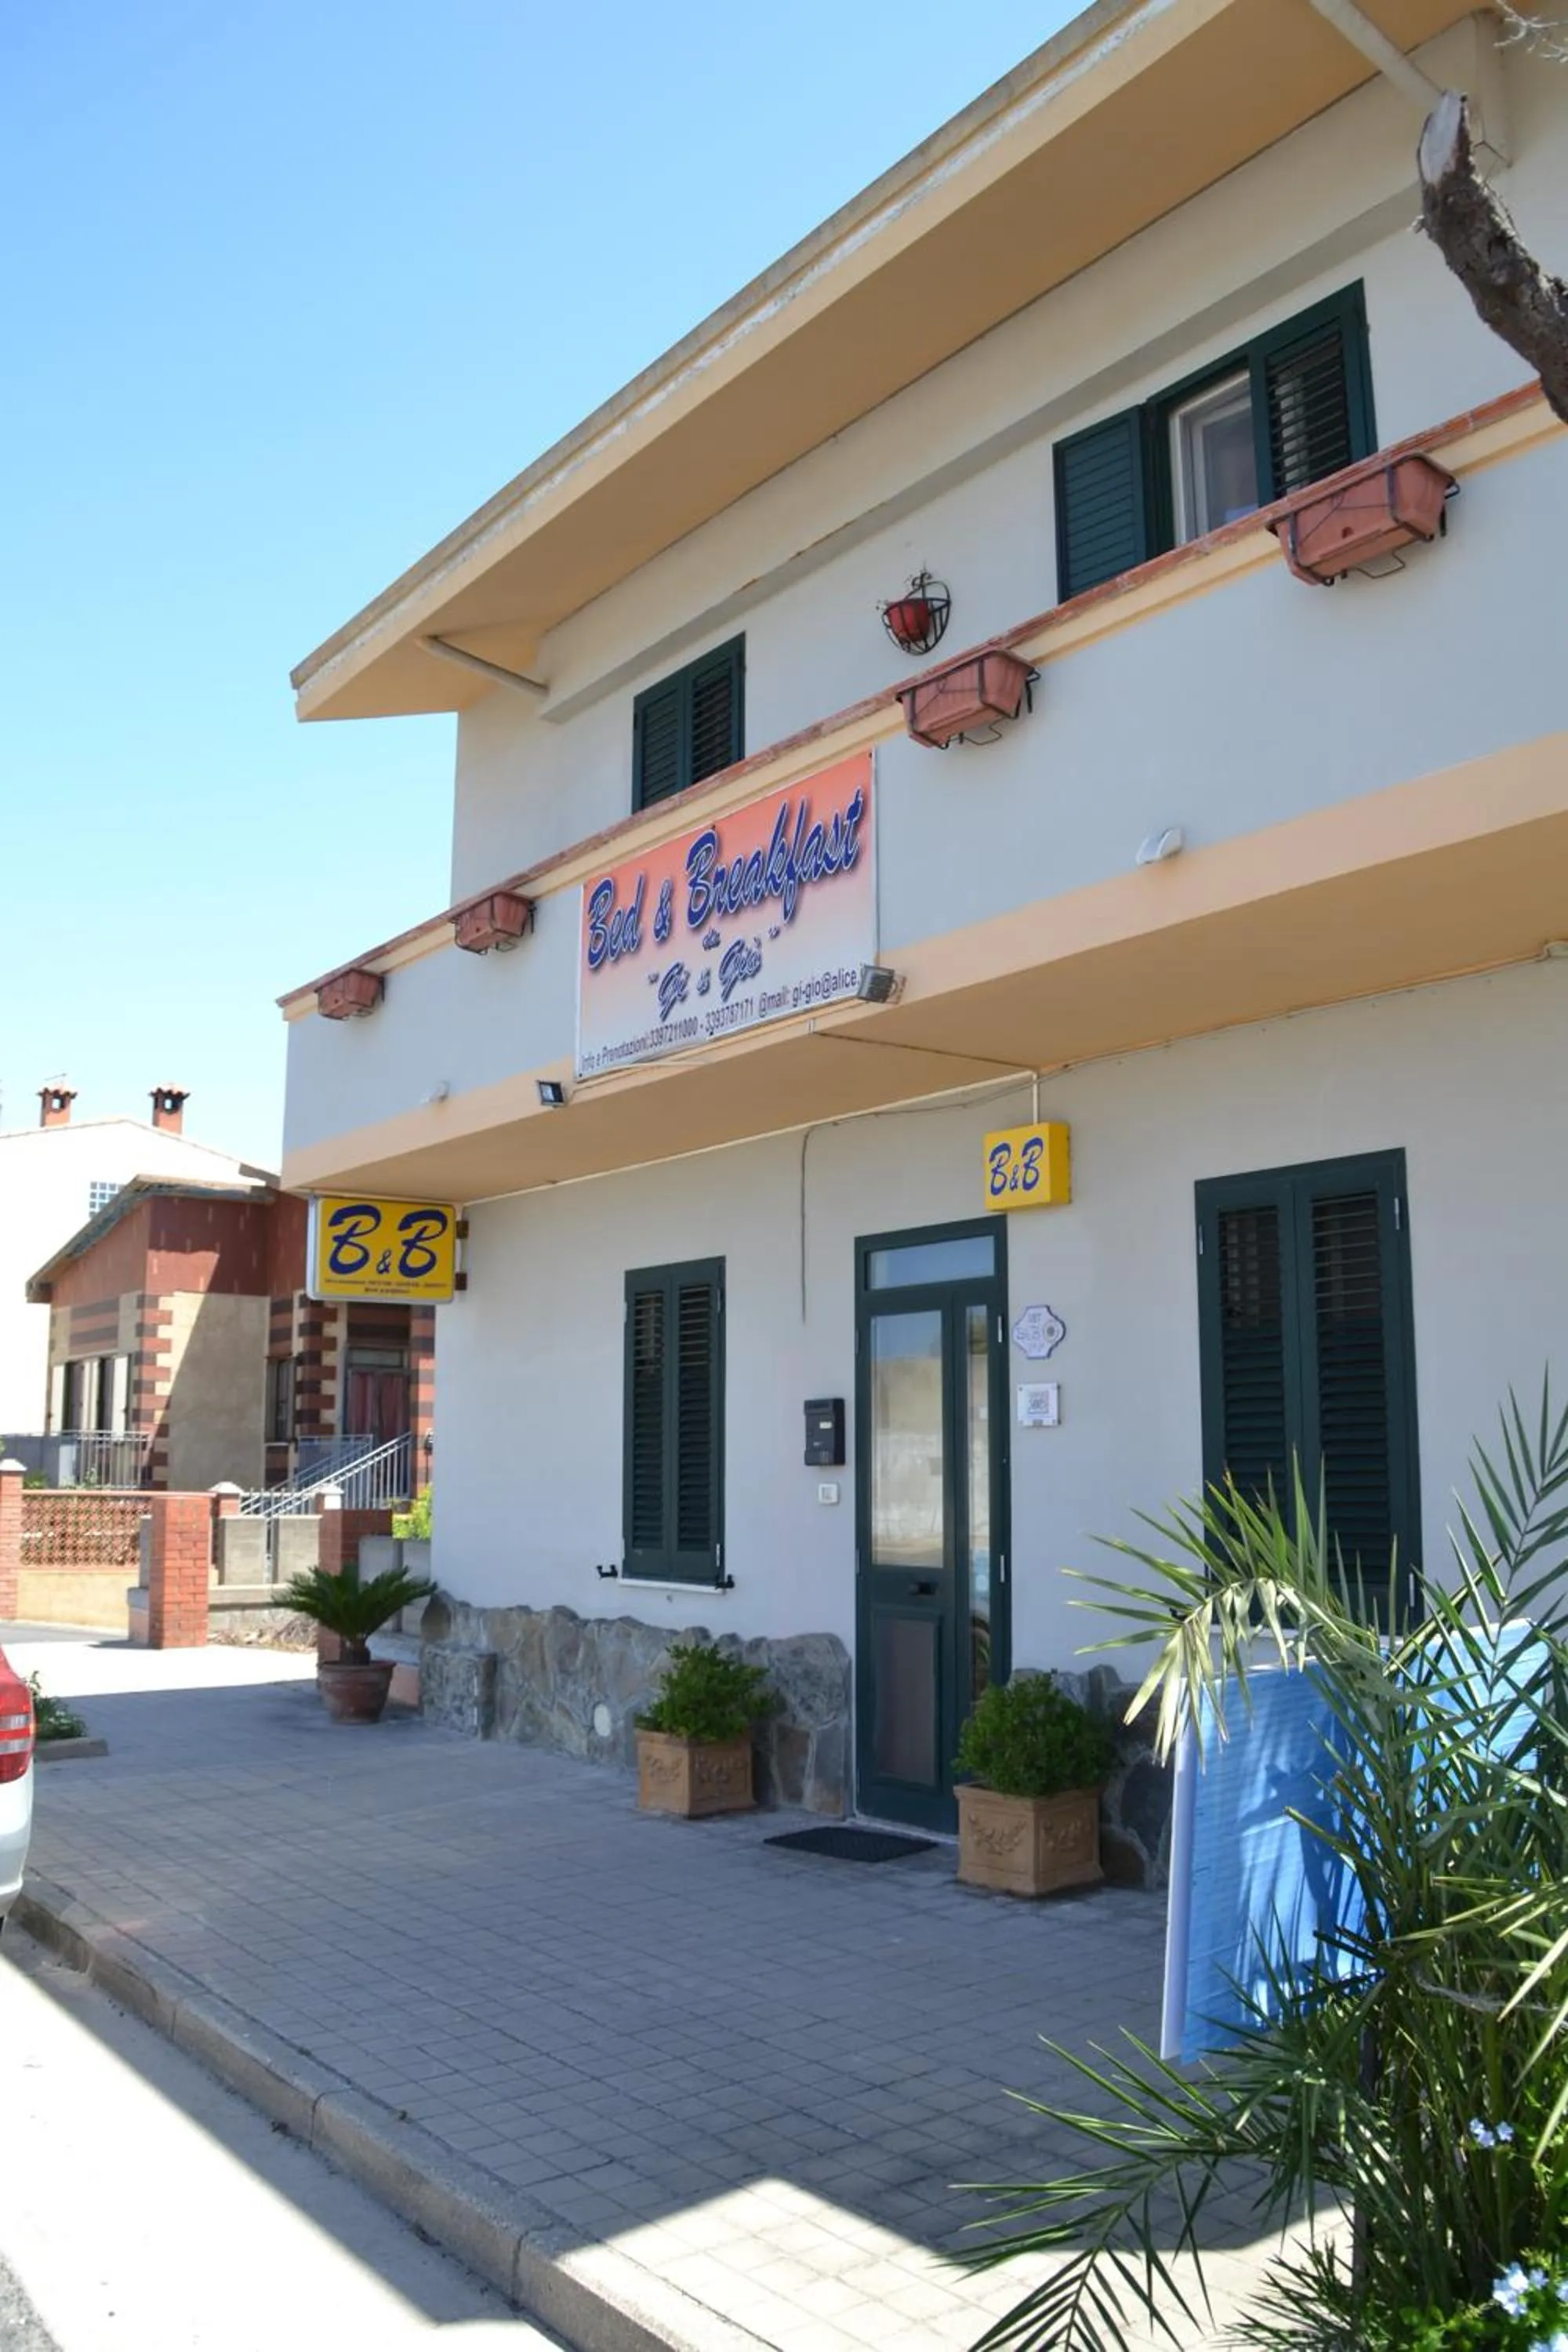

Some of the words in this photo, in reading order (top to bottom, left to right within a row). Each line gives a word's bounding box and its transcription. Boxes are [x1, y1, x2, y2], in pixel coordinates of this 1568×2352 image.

[588, 872, 645, 969] Bed
[653, 878, 673, 941] &
[686, 787, 866, 927] Breakfast
